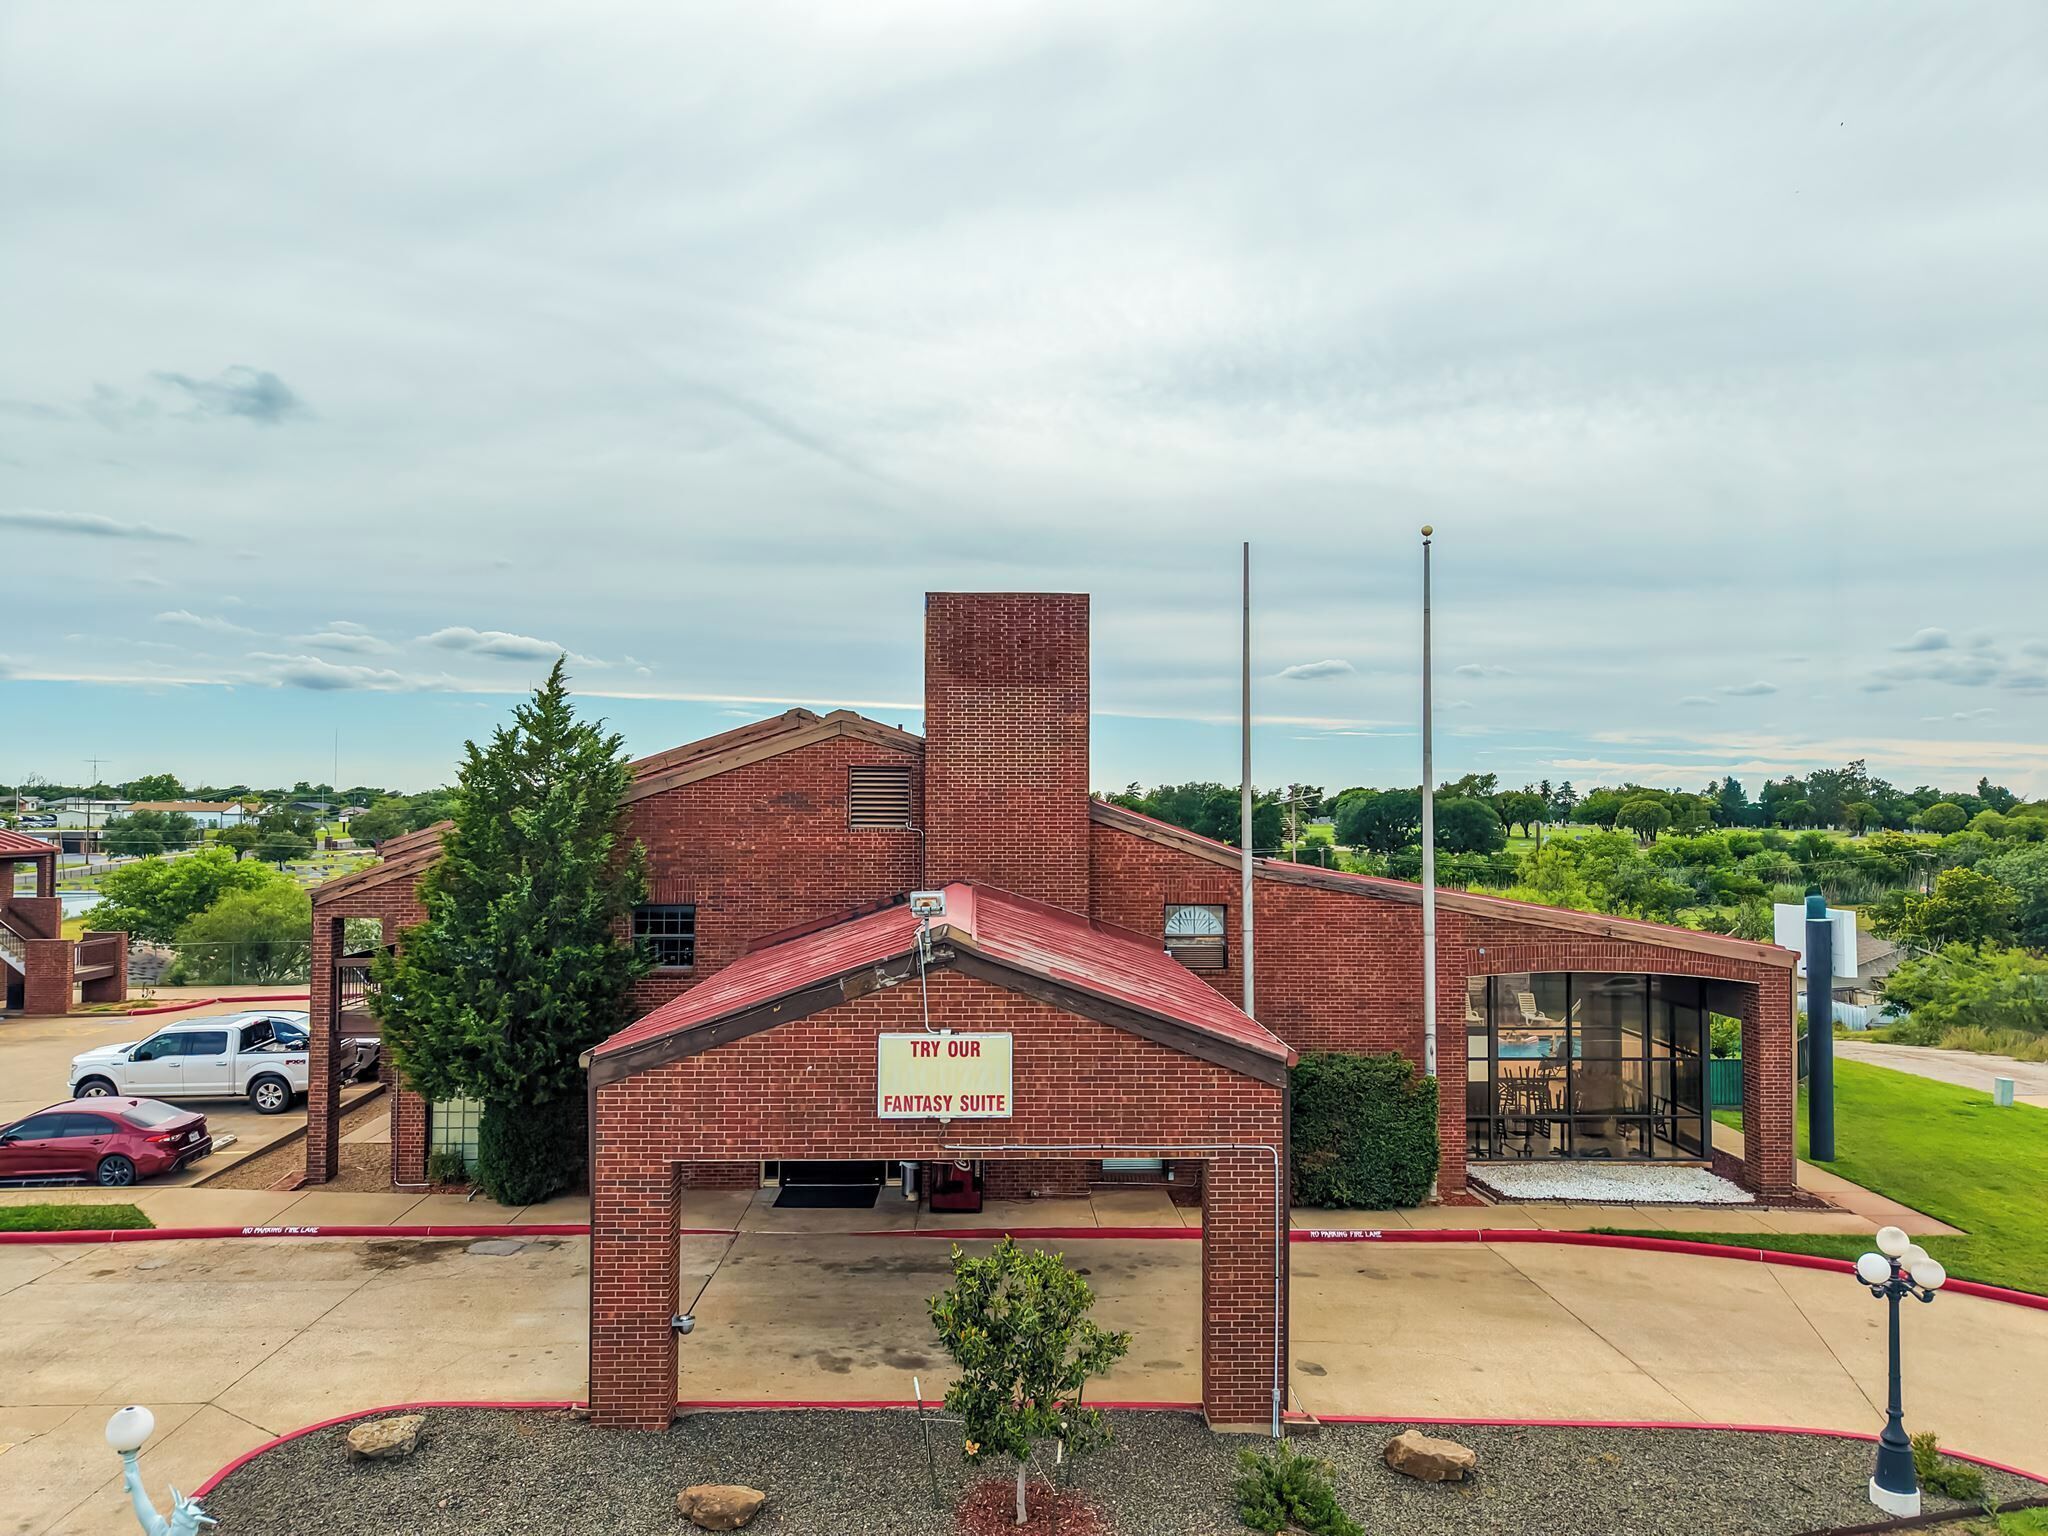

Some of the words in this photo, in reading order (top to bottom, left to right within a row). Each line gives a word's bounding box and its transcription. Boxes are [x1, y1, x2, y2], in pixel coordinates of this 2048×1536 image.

[911, 1041, 940, 1057] TRY
[948, 1041, 980, 1057] OUR
[884, 1095, 952, 1112] FANTASY
[960, 1095, 1005, 1112] SUITE
